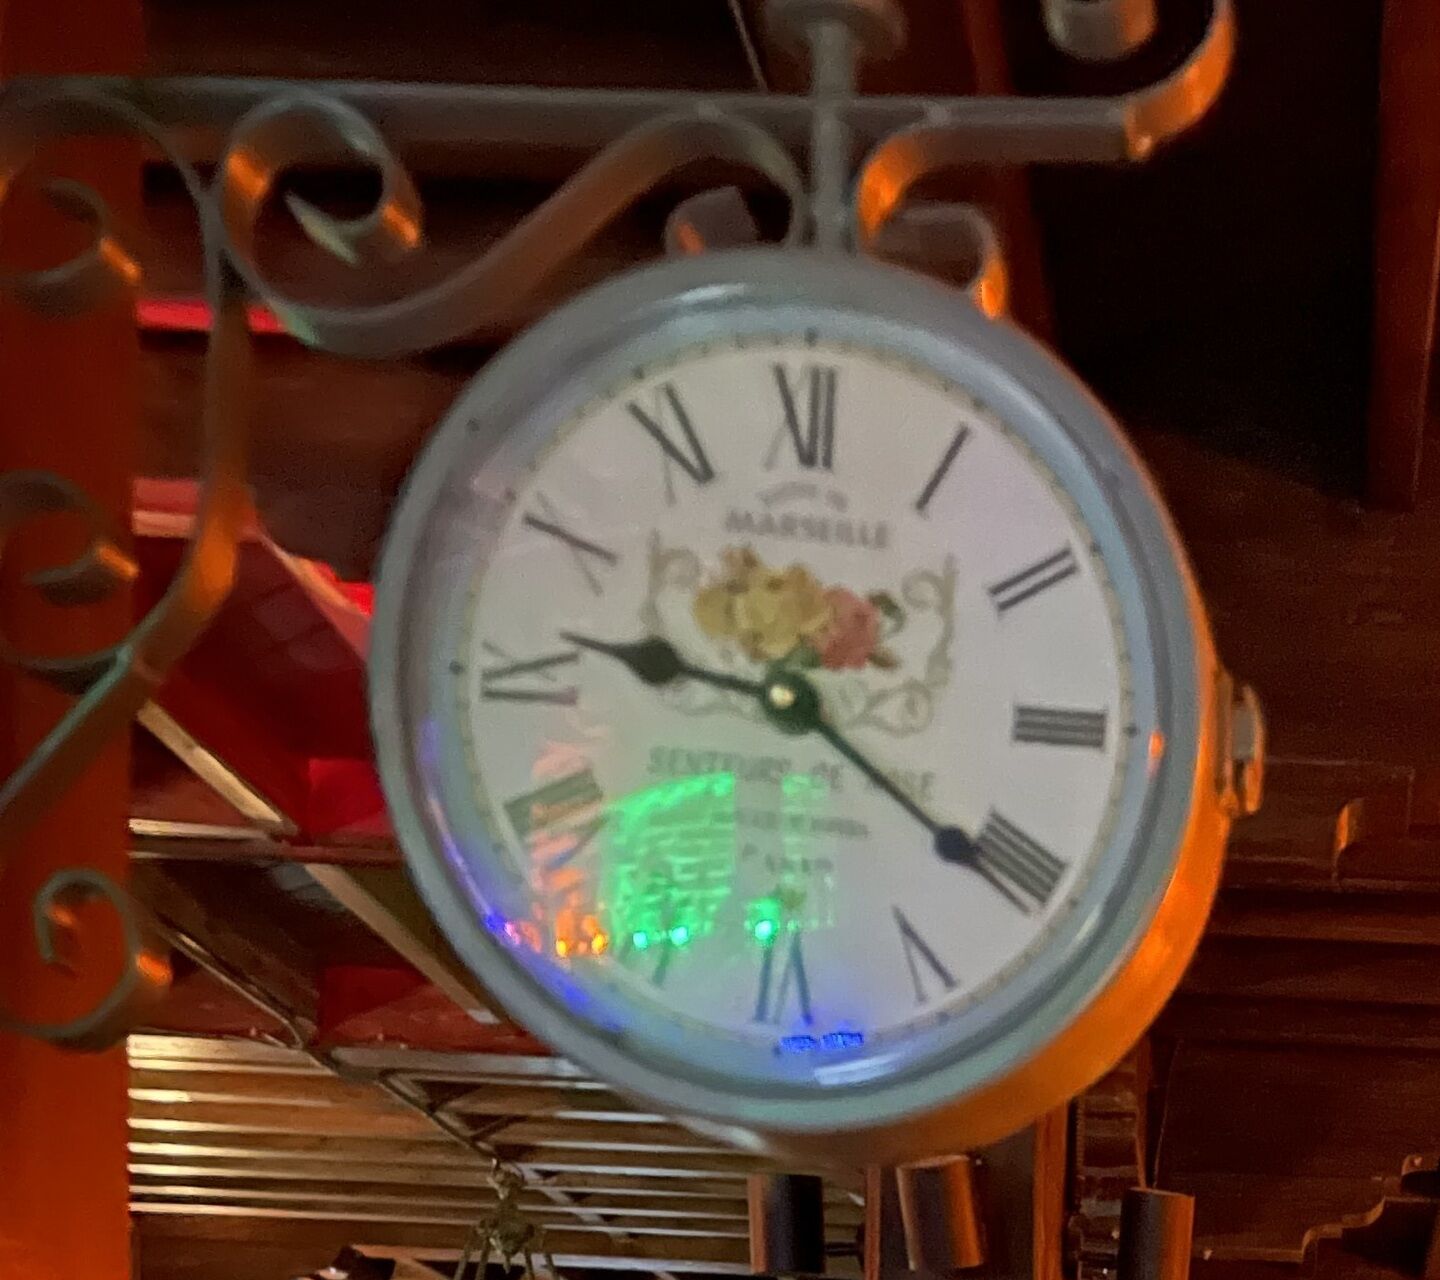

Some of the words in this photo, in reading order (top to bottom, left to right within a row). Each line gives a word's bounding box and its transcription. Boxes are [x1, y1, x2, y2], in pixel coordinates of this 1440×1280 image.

[627, 381, 715, 507] XI
[762, 362, 838, 470] XII
[725, 508, 890, 550] MARSEILLE
[988, 543, 1080, 613] II
[1011, 702, 1108, 750] III
